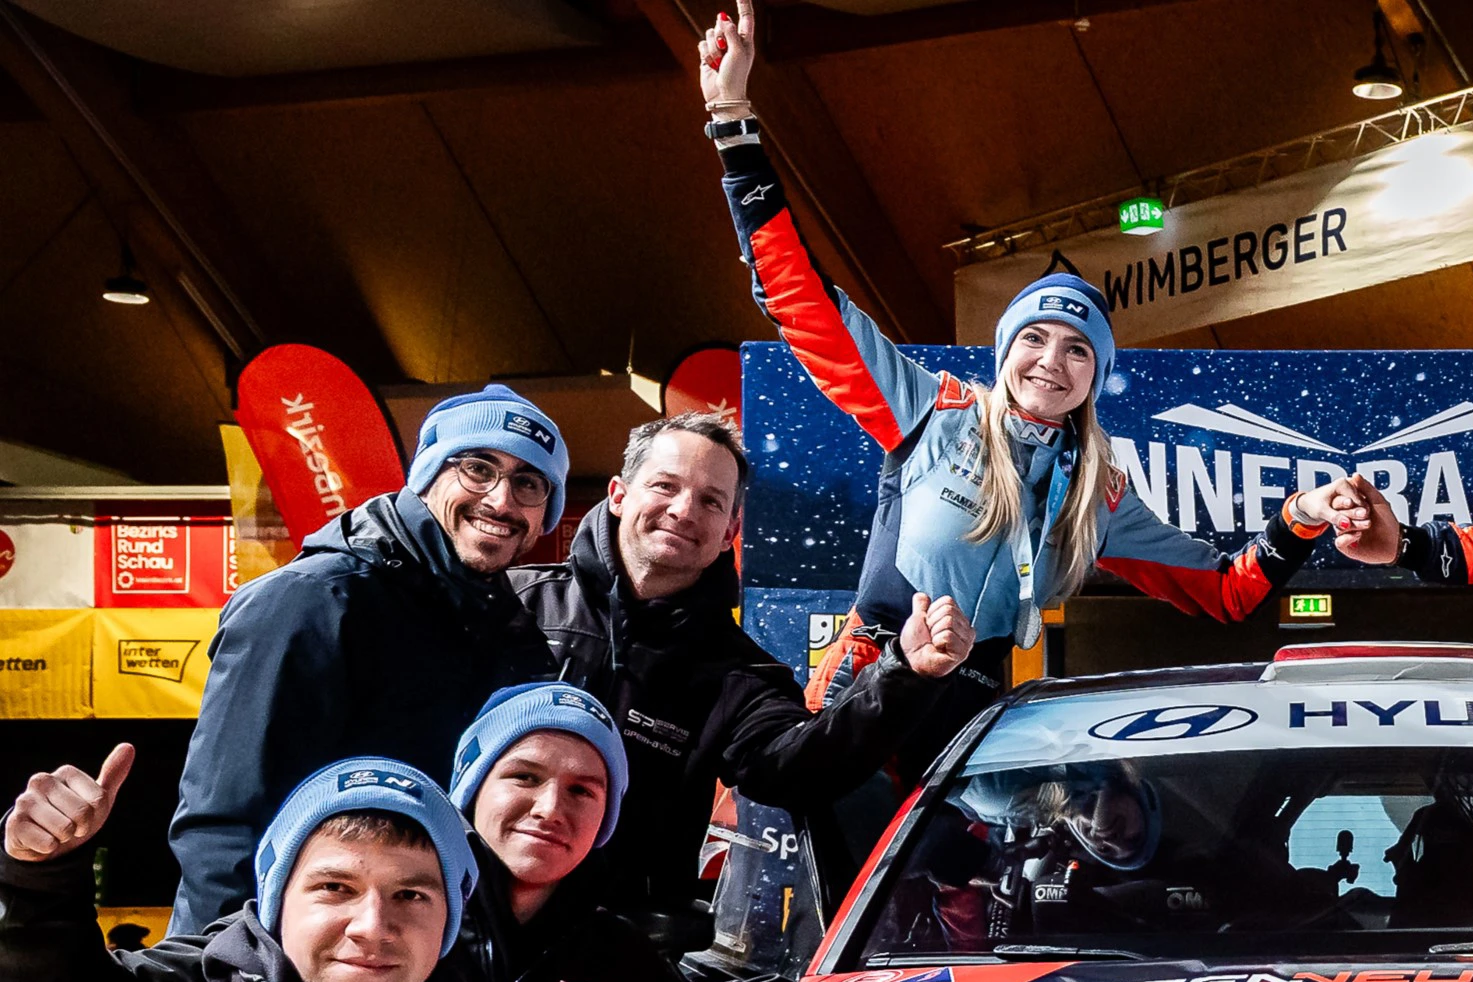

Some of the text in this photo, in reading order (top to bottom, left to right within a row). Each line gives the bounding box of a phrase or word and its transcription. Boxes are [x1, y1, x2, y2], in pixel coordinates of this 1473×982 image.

[1104, 207, 1348, 312] WIMBERGER
[117, 538, 164, 553] Rund
[117, 554, 174, 569] Schau
[0, 656, 47, 671] etten
[126, 656, 180, 669] wetten
